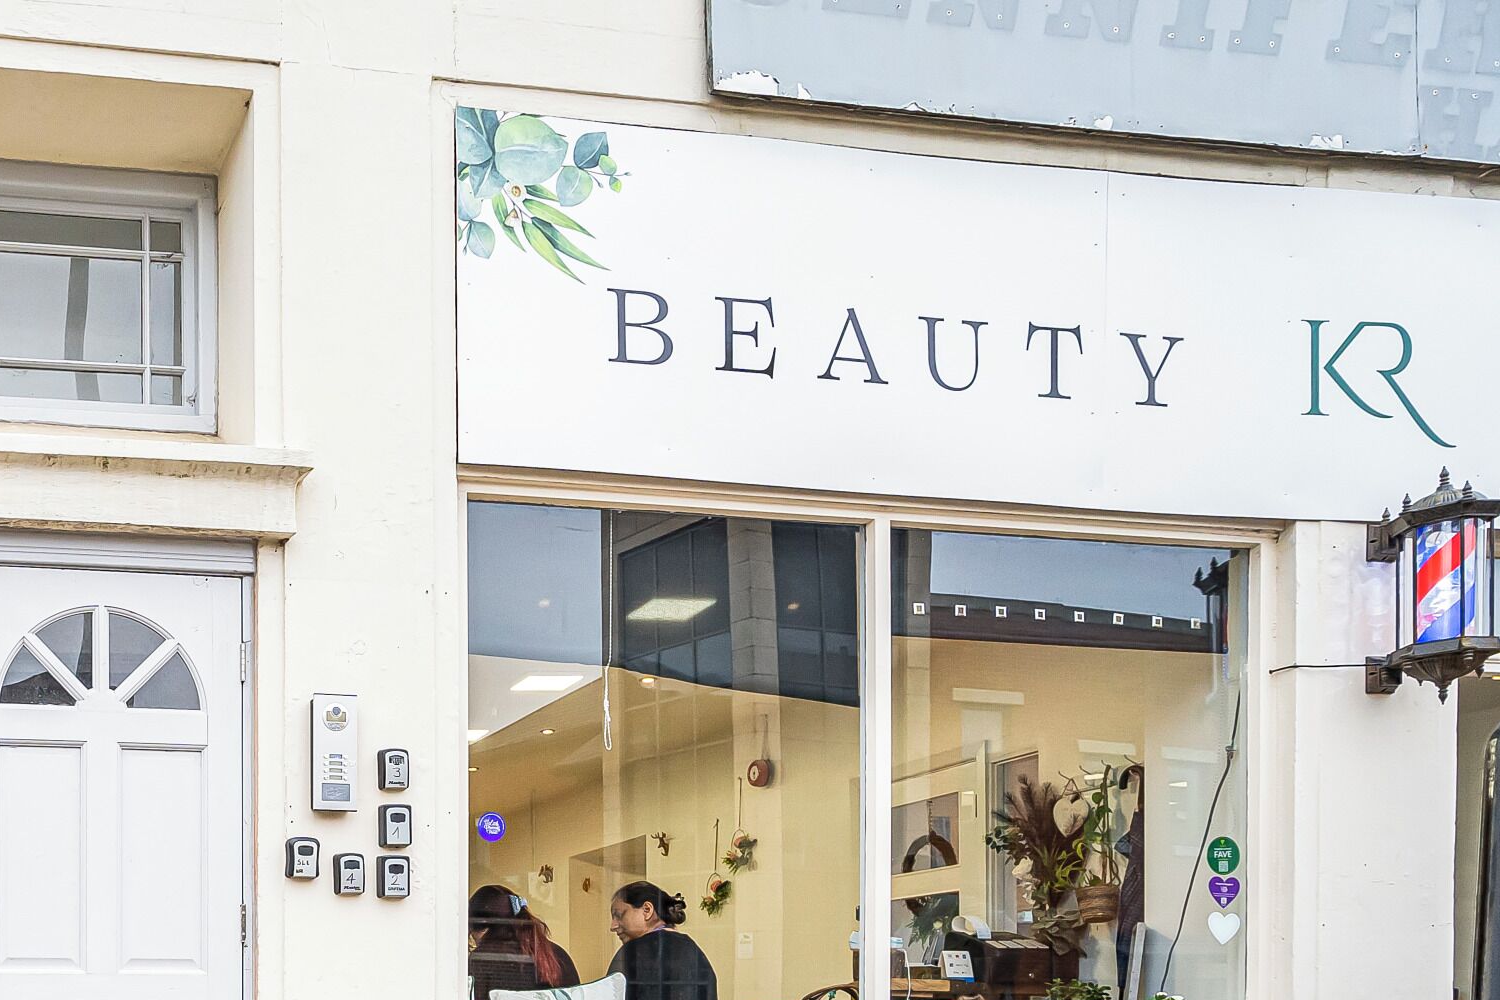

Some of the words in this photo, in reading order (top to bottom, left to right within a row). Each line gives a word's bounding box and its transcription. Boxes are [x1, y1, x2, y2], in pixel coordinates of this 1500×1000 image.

[606, 287, 1185, 407] BEAUTY
[1301, 319, 1457, 448] KR
[392, 767, 401, 778] 3
[391, 826, 400, 839] 1
[346, 872, 357, 885] 4
[391, 874, 401, 886] 2
